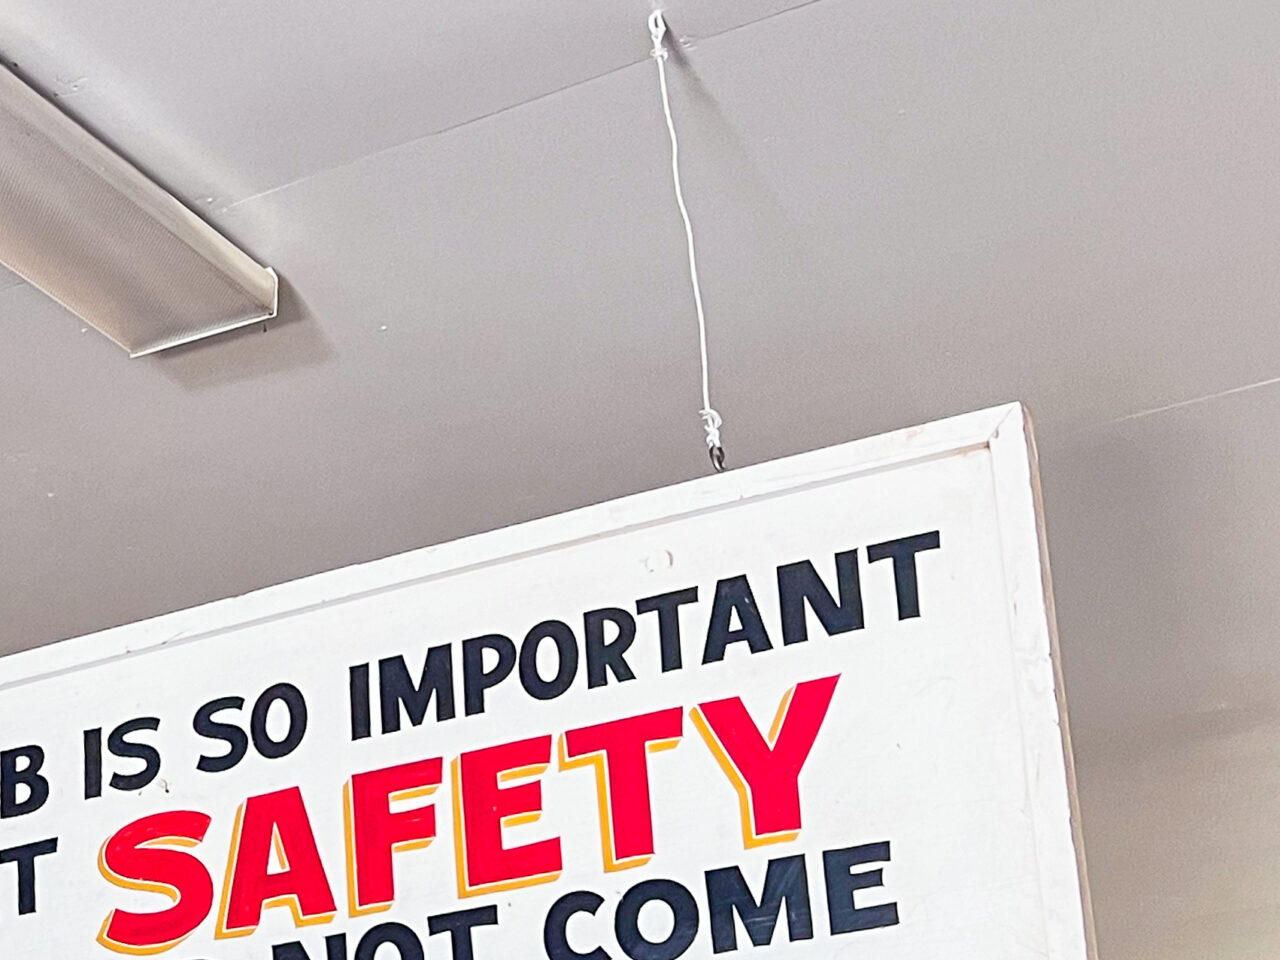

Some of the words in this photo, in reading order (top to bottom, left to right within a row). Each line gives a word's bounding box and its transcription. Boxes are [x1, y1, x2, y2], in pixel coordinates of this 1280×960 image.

[82, 716, 162, 802] IS
[191, 682, 309, 774] SO
[347, 529, 942, 742] IMPORTANT
[96, 673, 842, 957] SAFETY
